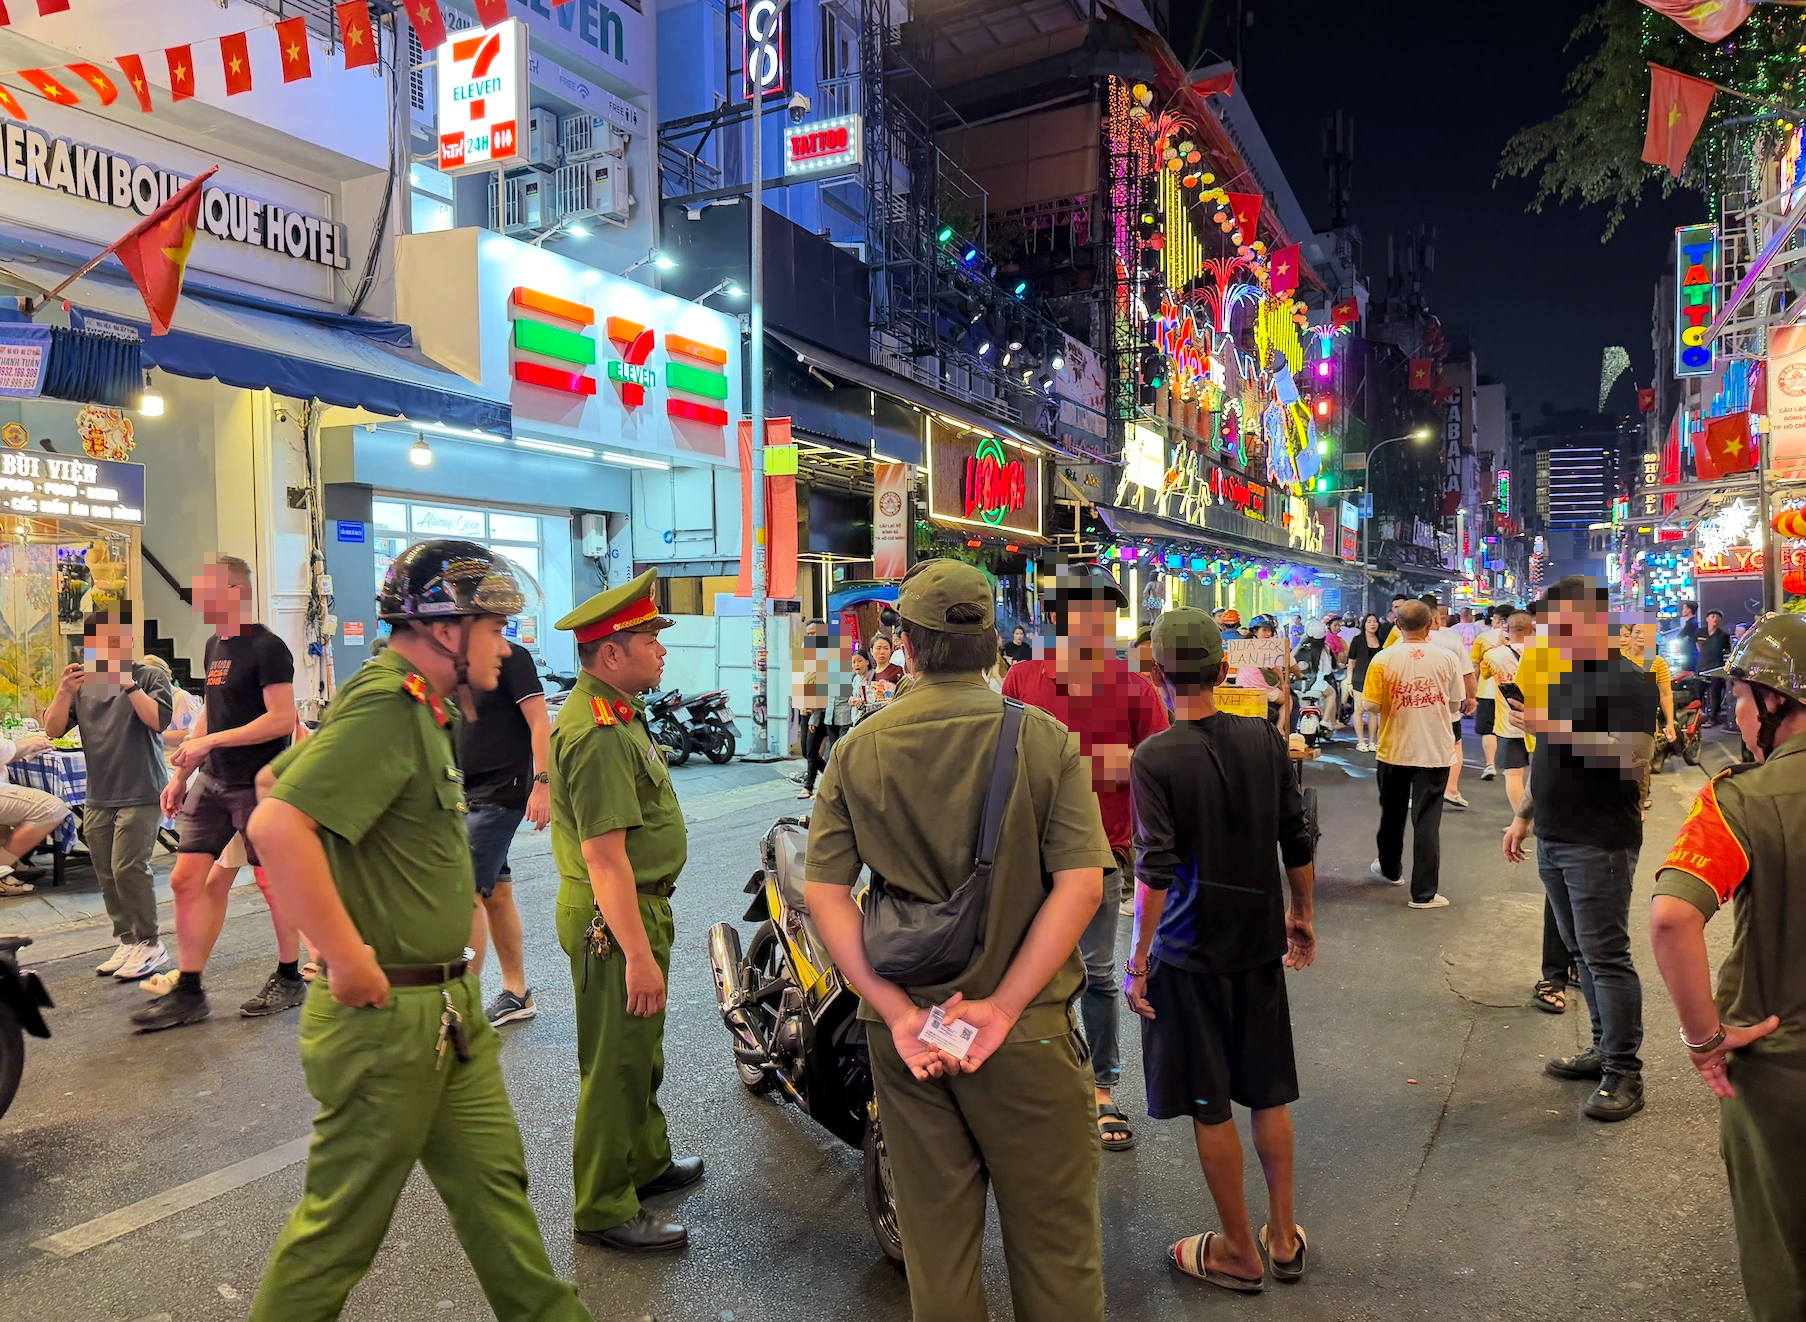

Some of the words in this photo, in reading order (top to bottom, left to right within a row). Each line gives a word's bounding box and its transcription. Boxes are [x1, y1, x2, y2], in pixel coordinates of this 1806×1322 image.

[559, 75, 577, 92] FREE
[609, 101, 625, 117] FREE
[466, 134, 489, 154] 24H
[790, 126, 848, 157] TATTOO
[0, 122, 108, 203] ERAKI
[265, 204, 347, 269] HOTEL
[1682, 243, 1711, 368] TATTOO
[1446, 386, 1462, 493] CABANA
[2, 452, 41, 479] BÙI
[46, 458, 99, 486] VIỆN
